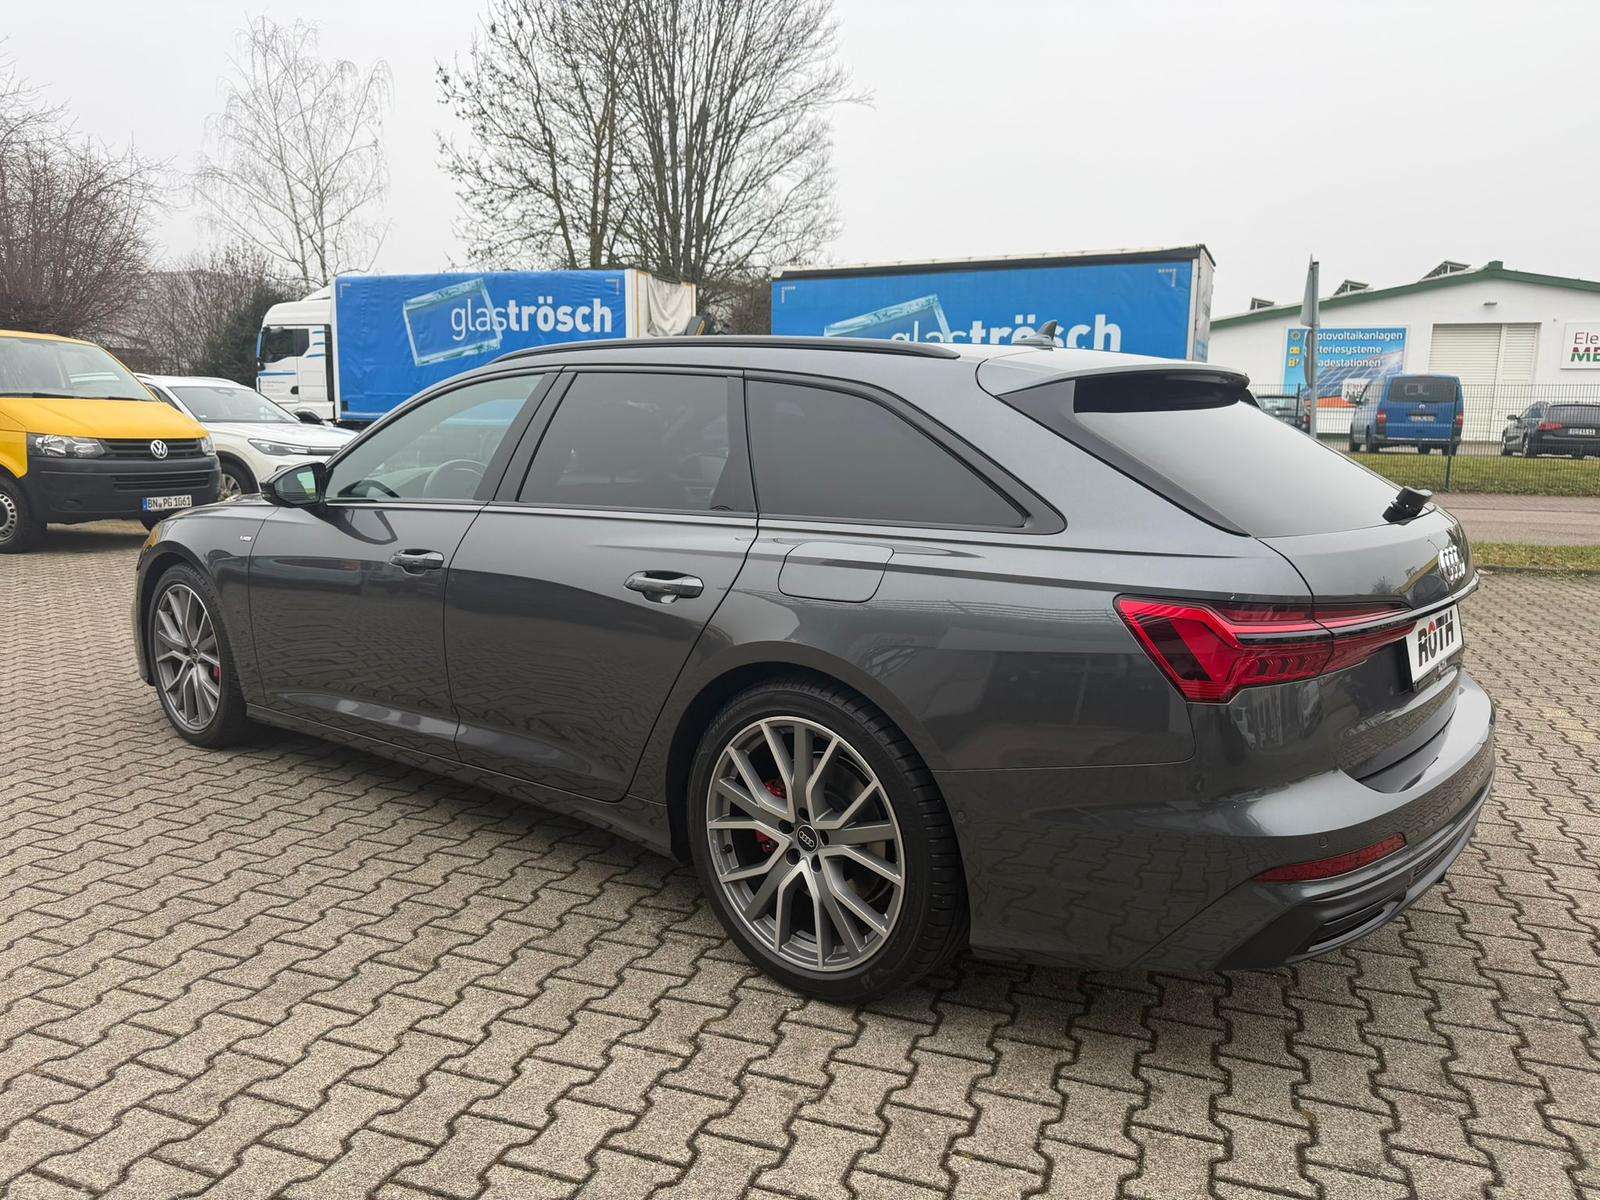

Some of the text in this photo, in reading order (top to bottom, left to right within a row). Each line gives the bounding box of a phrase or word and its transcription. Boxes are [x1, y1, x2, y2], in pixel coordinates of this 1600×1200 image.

[451, 296, 613, 341] glaströsch
[1304, 331, 1403, 342] otovoltaikanlagen
[1304, 344, 1382, 355] teriesysteme
[1417, 609, 1455, 668] ROTH
